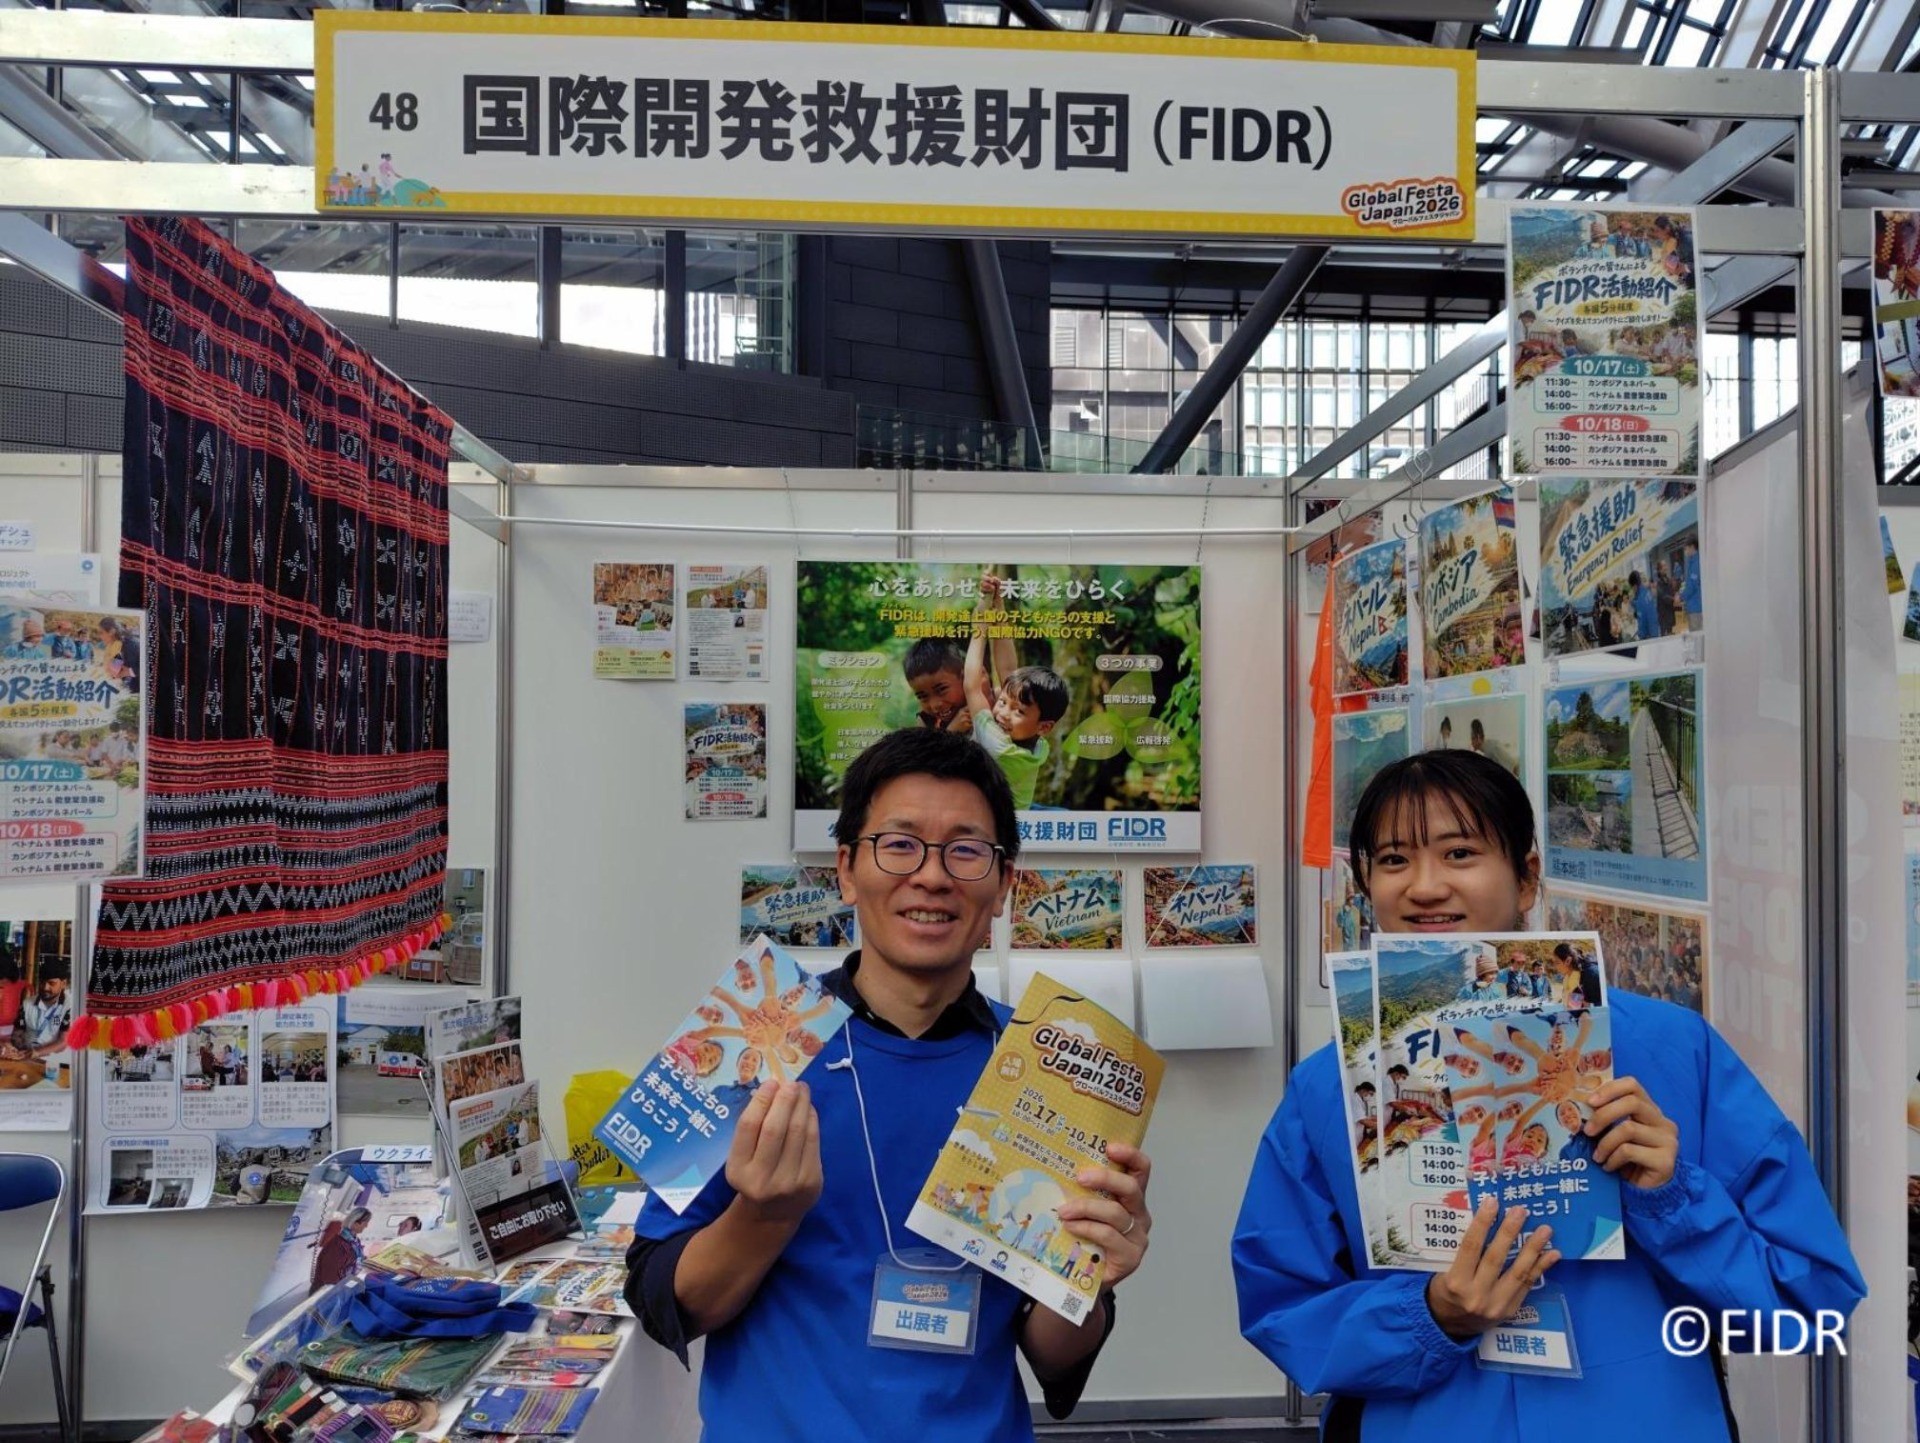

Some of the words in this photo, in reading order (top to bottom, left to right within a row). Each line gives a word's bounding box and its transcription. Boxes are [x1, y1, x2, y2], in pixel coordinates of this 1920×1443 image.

[369, 92, 419, 132] 48
[1348, 187, 1403, 208] Global
[1405, 183, 1454, 204] Festa
[1558, 261, 1648, 277] ボランティアの皆さんによる
[1532, 274, 1678, 311] FIDR活動紹介
[1573, 358, 1641, 376] 10/17(土)
[1575, 416, 1640, 432] 10/18(日)
[1558, 483, 1637, 576] 緊急援助
[1567, 547, 1610, 597] Emergency
[1611, 517, 1644, 559] Relief
[1350, 614, 1377, 653] Nepal
[1107, 817, 1167, 837] FIDR
[1027, 881, 1106, 918] ベトナム
[1169, 884, 1237, 913] ネパール
[1044, 909, 1101, 931] Vietnam
[1180, 903, 1223, 926] Nepal
[1035, 1028, 1101, 1064] Global
[1099, 1050, 1144, 1084] Festa
[658, 1054, 730, 1120] 子どもたちの
[629, 1086, 691, 1143] ひらこう!
[642, 1070, 717, 1139] 未来を一緒に
[1015, 1097, 1057, 1124] 10.17
[603, 1111, 653, 1155] FIDR
[1422, 1144, 1463, 1156] 11:30~
[1421, 1159, 1464, 1170] 14:00~
[1502, 1157, 1588, 1182] 子どもたちの
[1422, 1173, 1465, 1185] 16:00~
[1503, 1177, 1590, 1202] 未来を一緒に
[488, 1200, 567, 1240] ご自由にお取り下さい
[1424, 1208, 1466, 1220] 11:30~
[1424, 1223, 1466, 1234] 14:00~
[962, 1243, 980, 1256] JICA
[1424, 1237, 1460, 1249] 16:00
[895, 1309, 949, 1335] 出展者
[1495, 1332, 1547, 1357] 出展者
